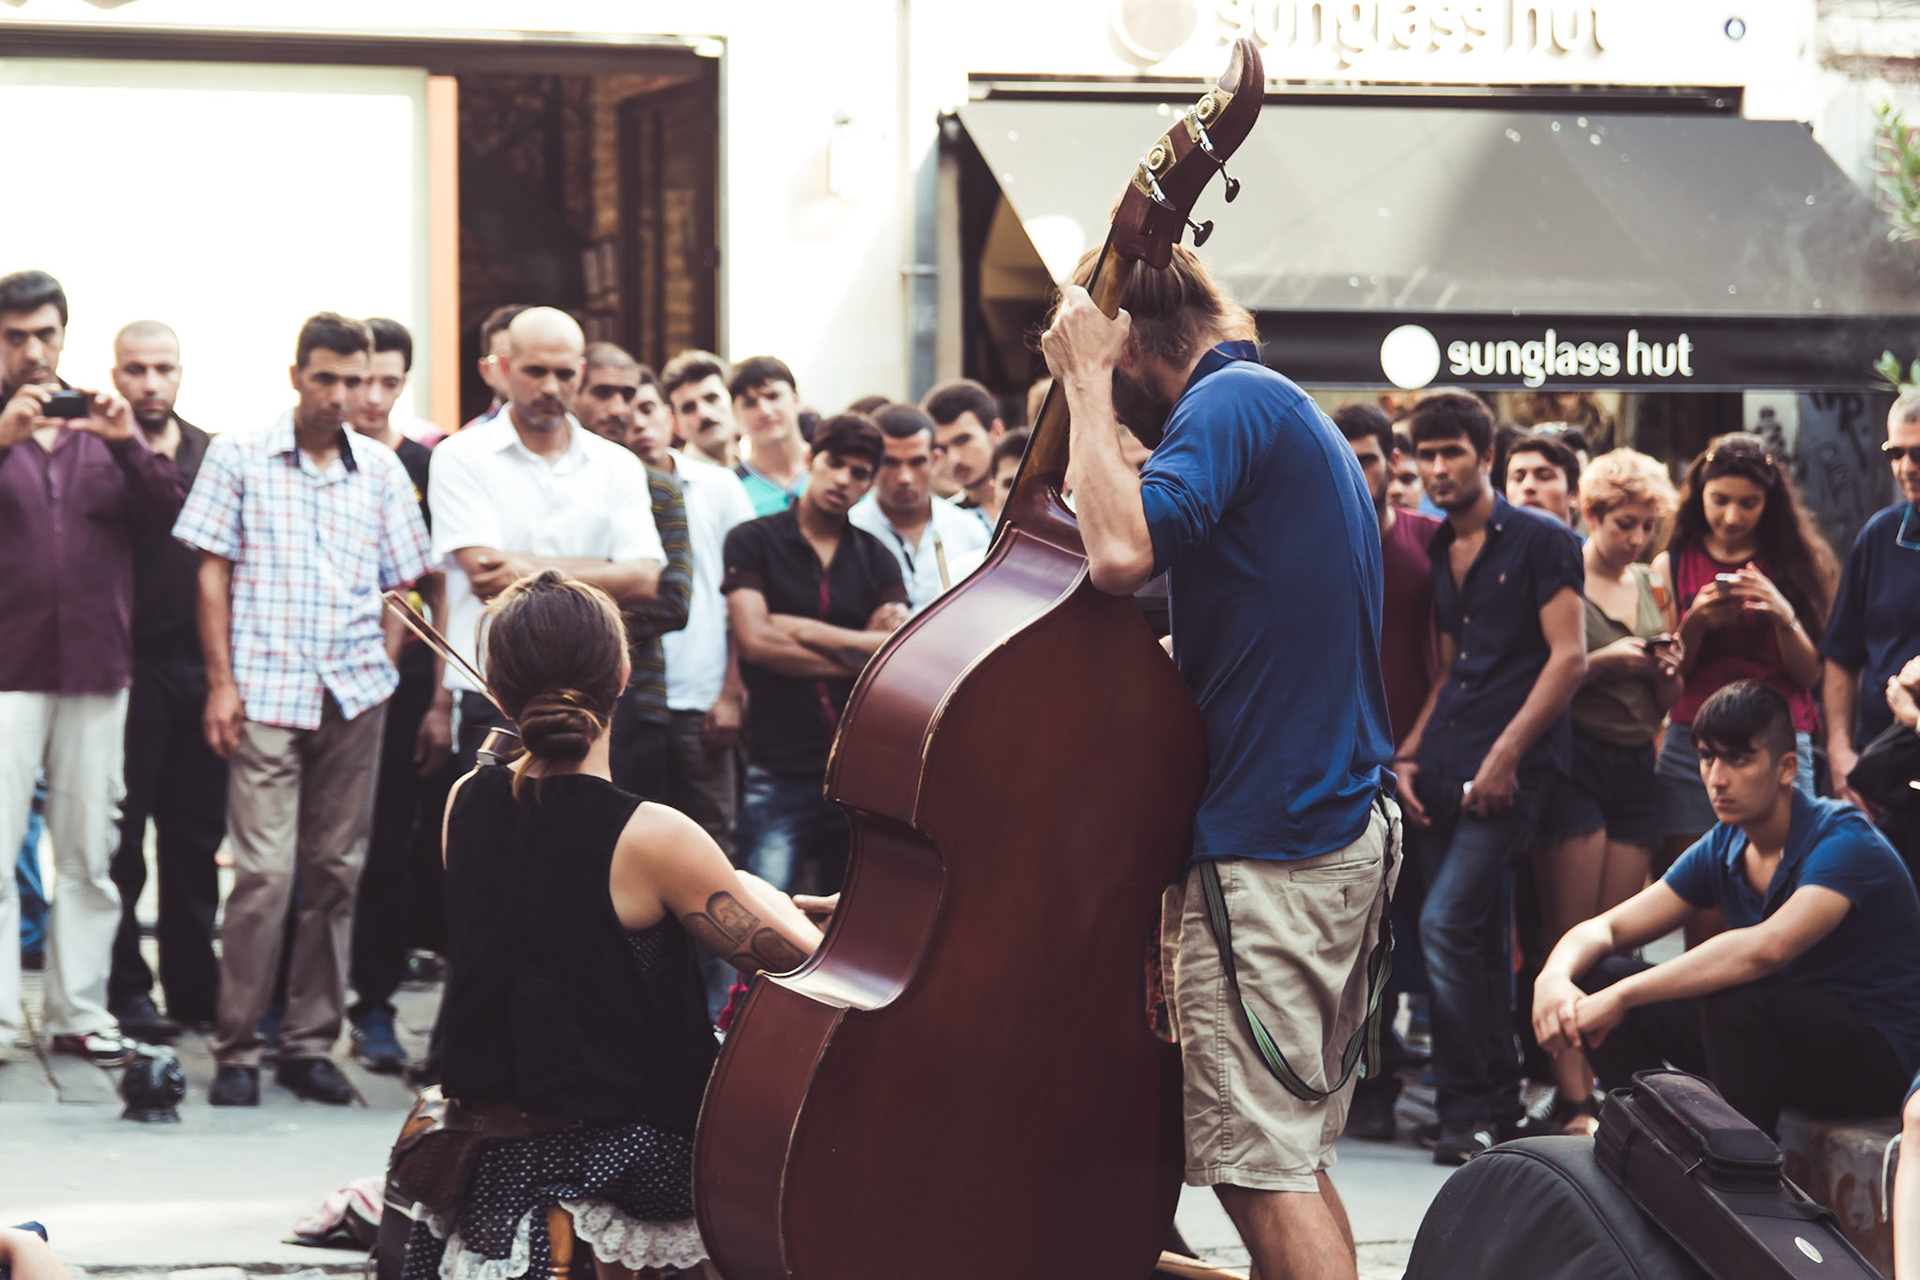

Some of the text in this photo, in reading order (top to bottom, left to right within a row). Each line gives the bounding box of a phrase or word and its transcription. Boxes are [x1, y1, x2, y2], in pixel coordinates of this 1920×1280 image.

[1213, 0, 1489, 70] sunglass
[1447, 328, 1694, 388] sunglass hut
